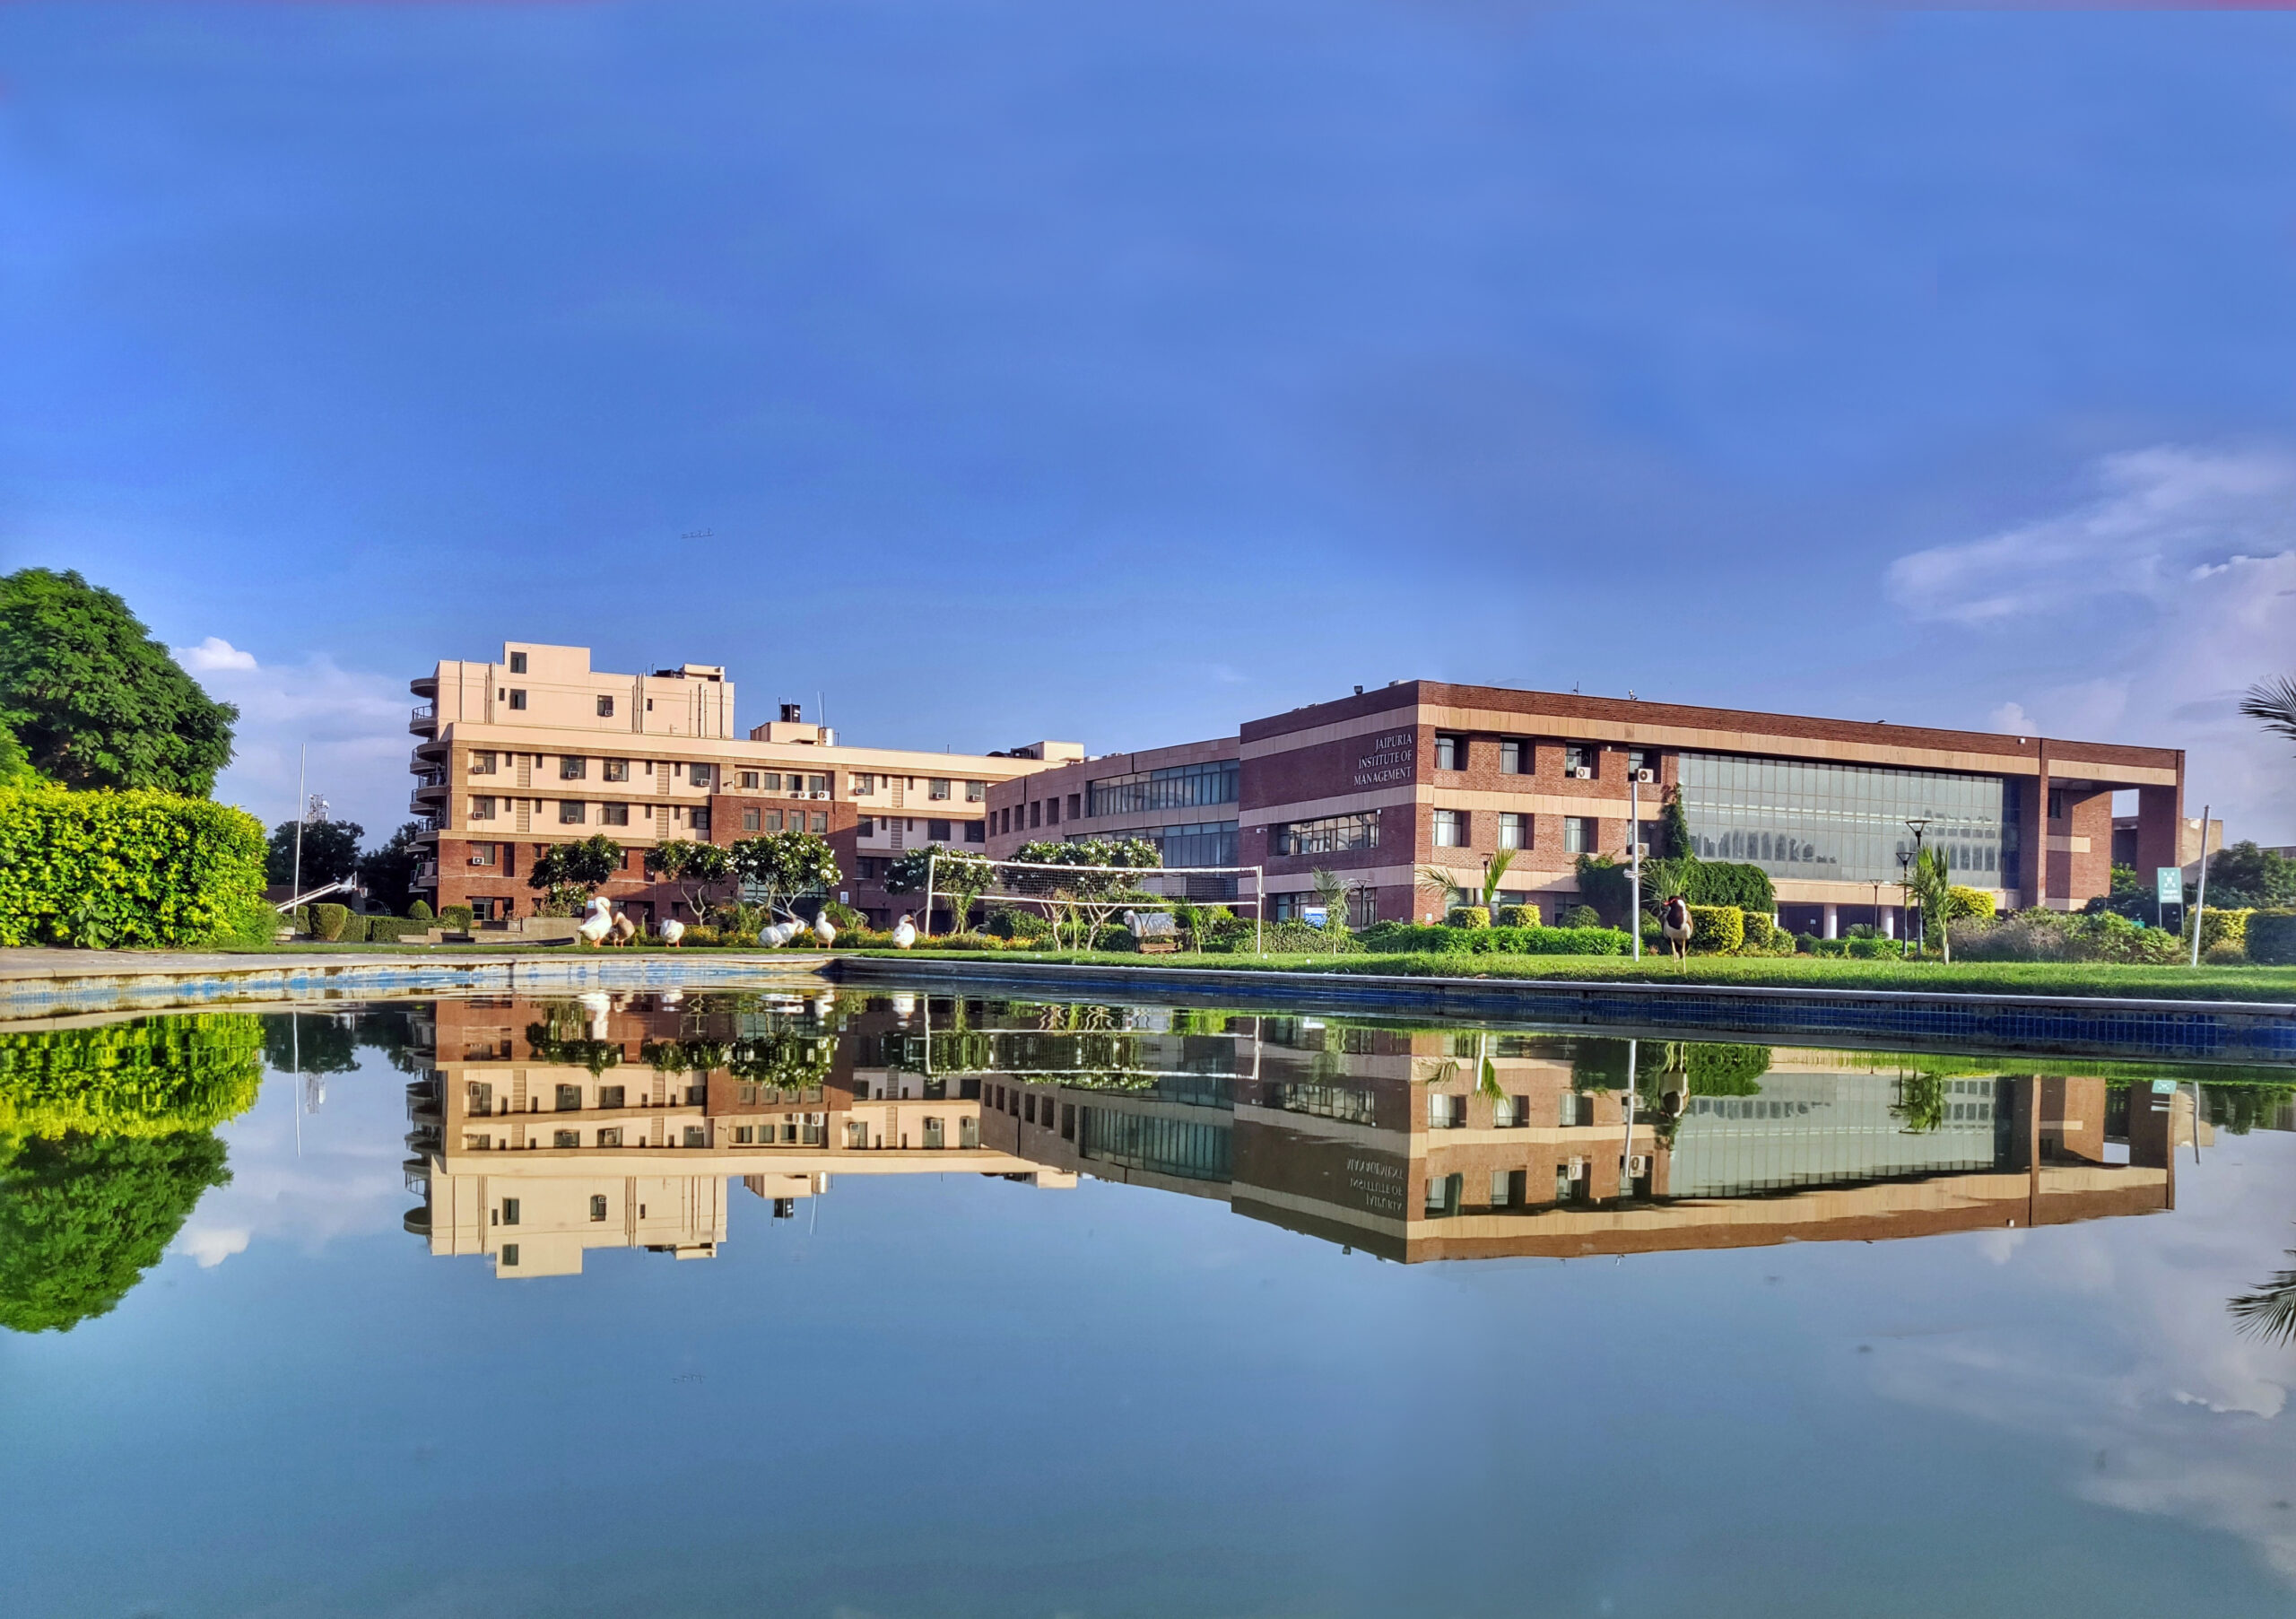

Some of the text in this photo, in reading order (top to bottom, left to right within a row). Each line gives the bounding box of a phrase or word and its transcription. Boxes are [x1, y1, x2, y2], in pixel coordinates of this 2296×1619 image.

[1375, 734, 1413, 753] JAIPURIA
[1358, 750, 1413, 770] INSTITUTE OF
[1353, 767, 1412, 786] MANAGEMENT
